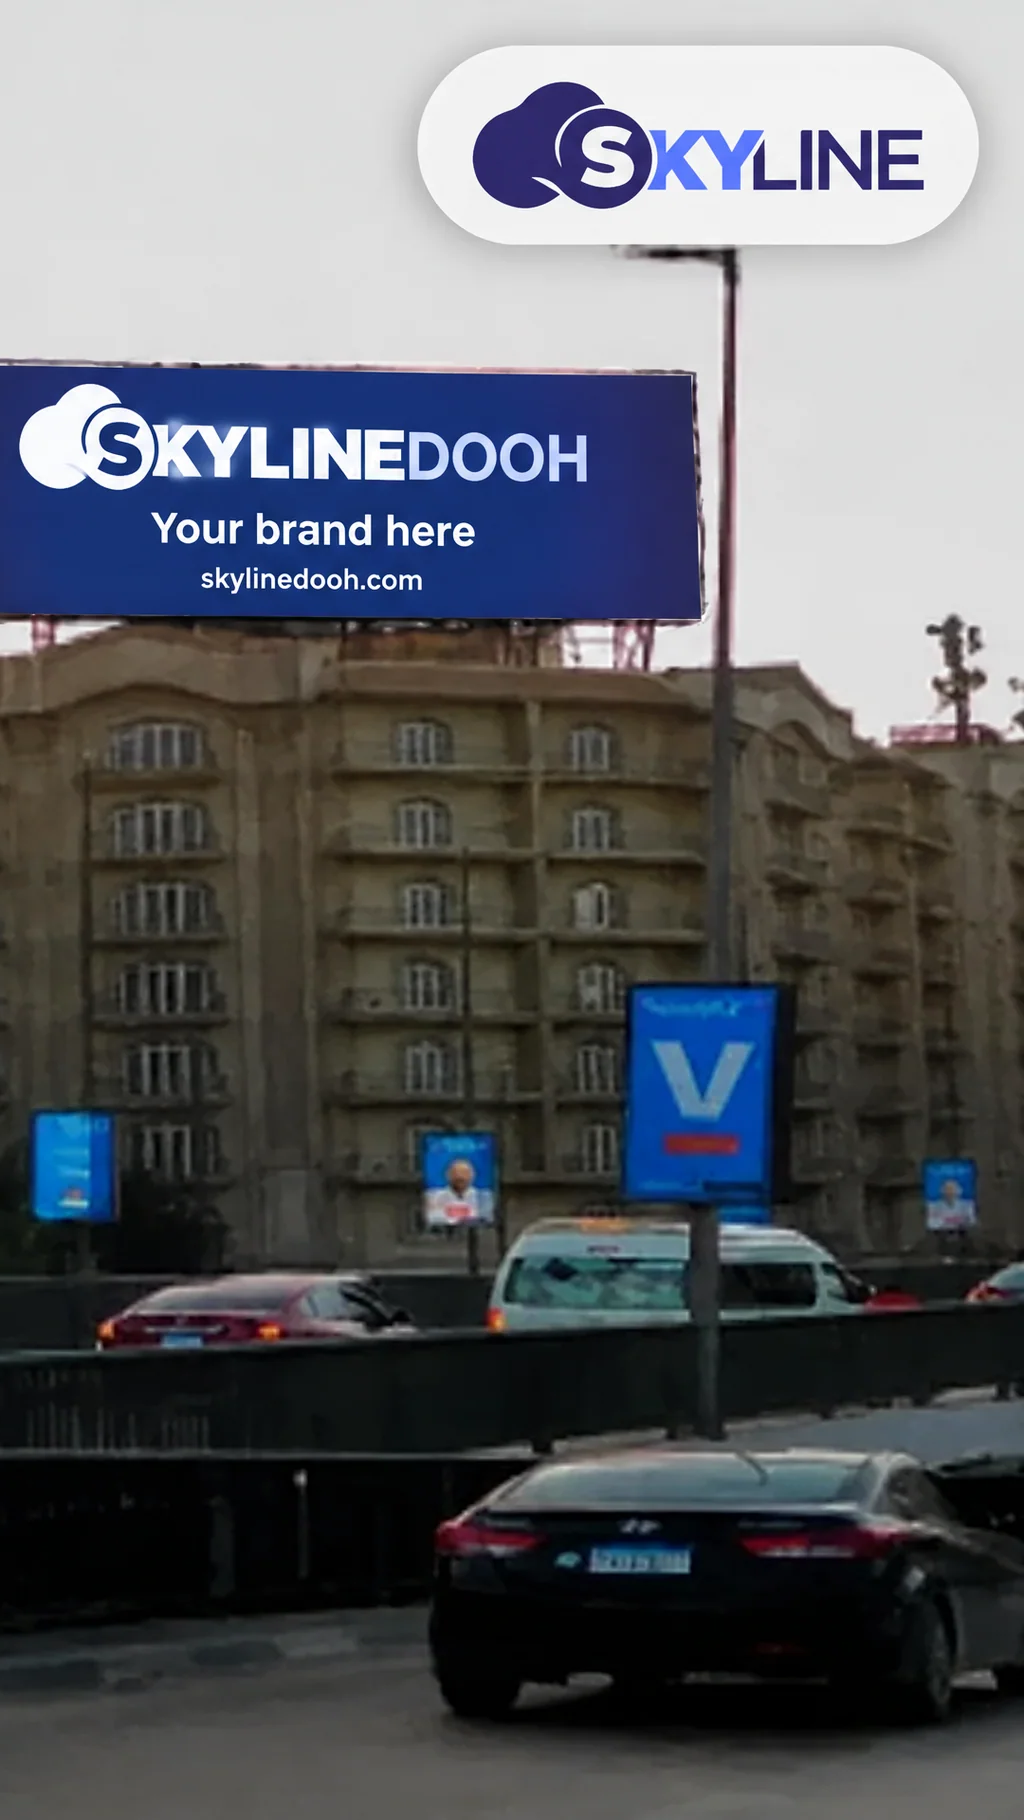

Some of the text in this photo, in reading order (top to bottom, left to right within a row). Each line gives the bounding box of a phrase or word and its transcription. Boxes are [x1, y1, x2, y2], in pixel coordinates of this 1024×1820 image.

[97, 421, 587, 483] SKYLINEDOOH
[151, 511, 476, 547] Your brand here
[200, 566, 423, 594] skylinedooh.com
